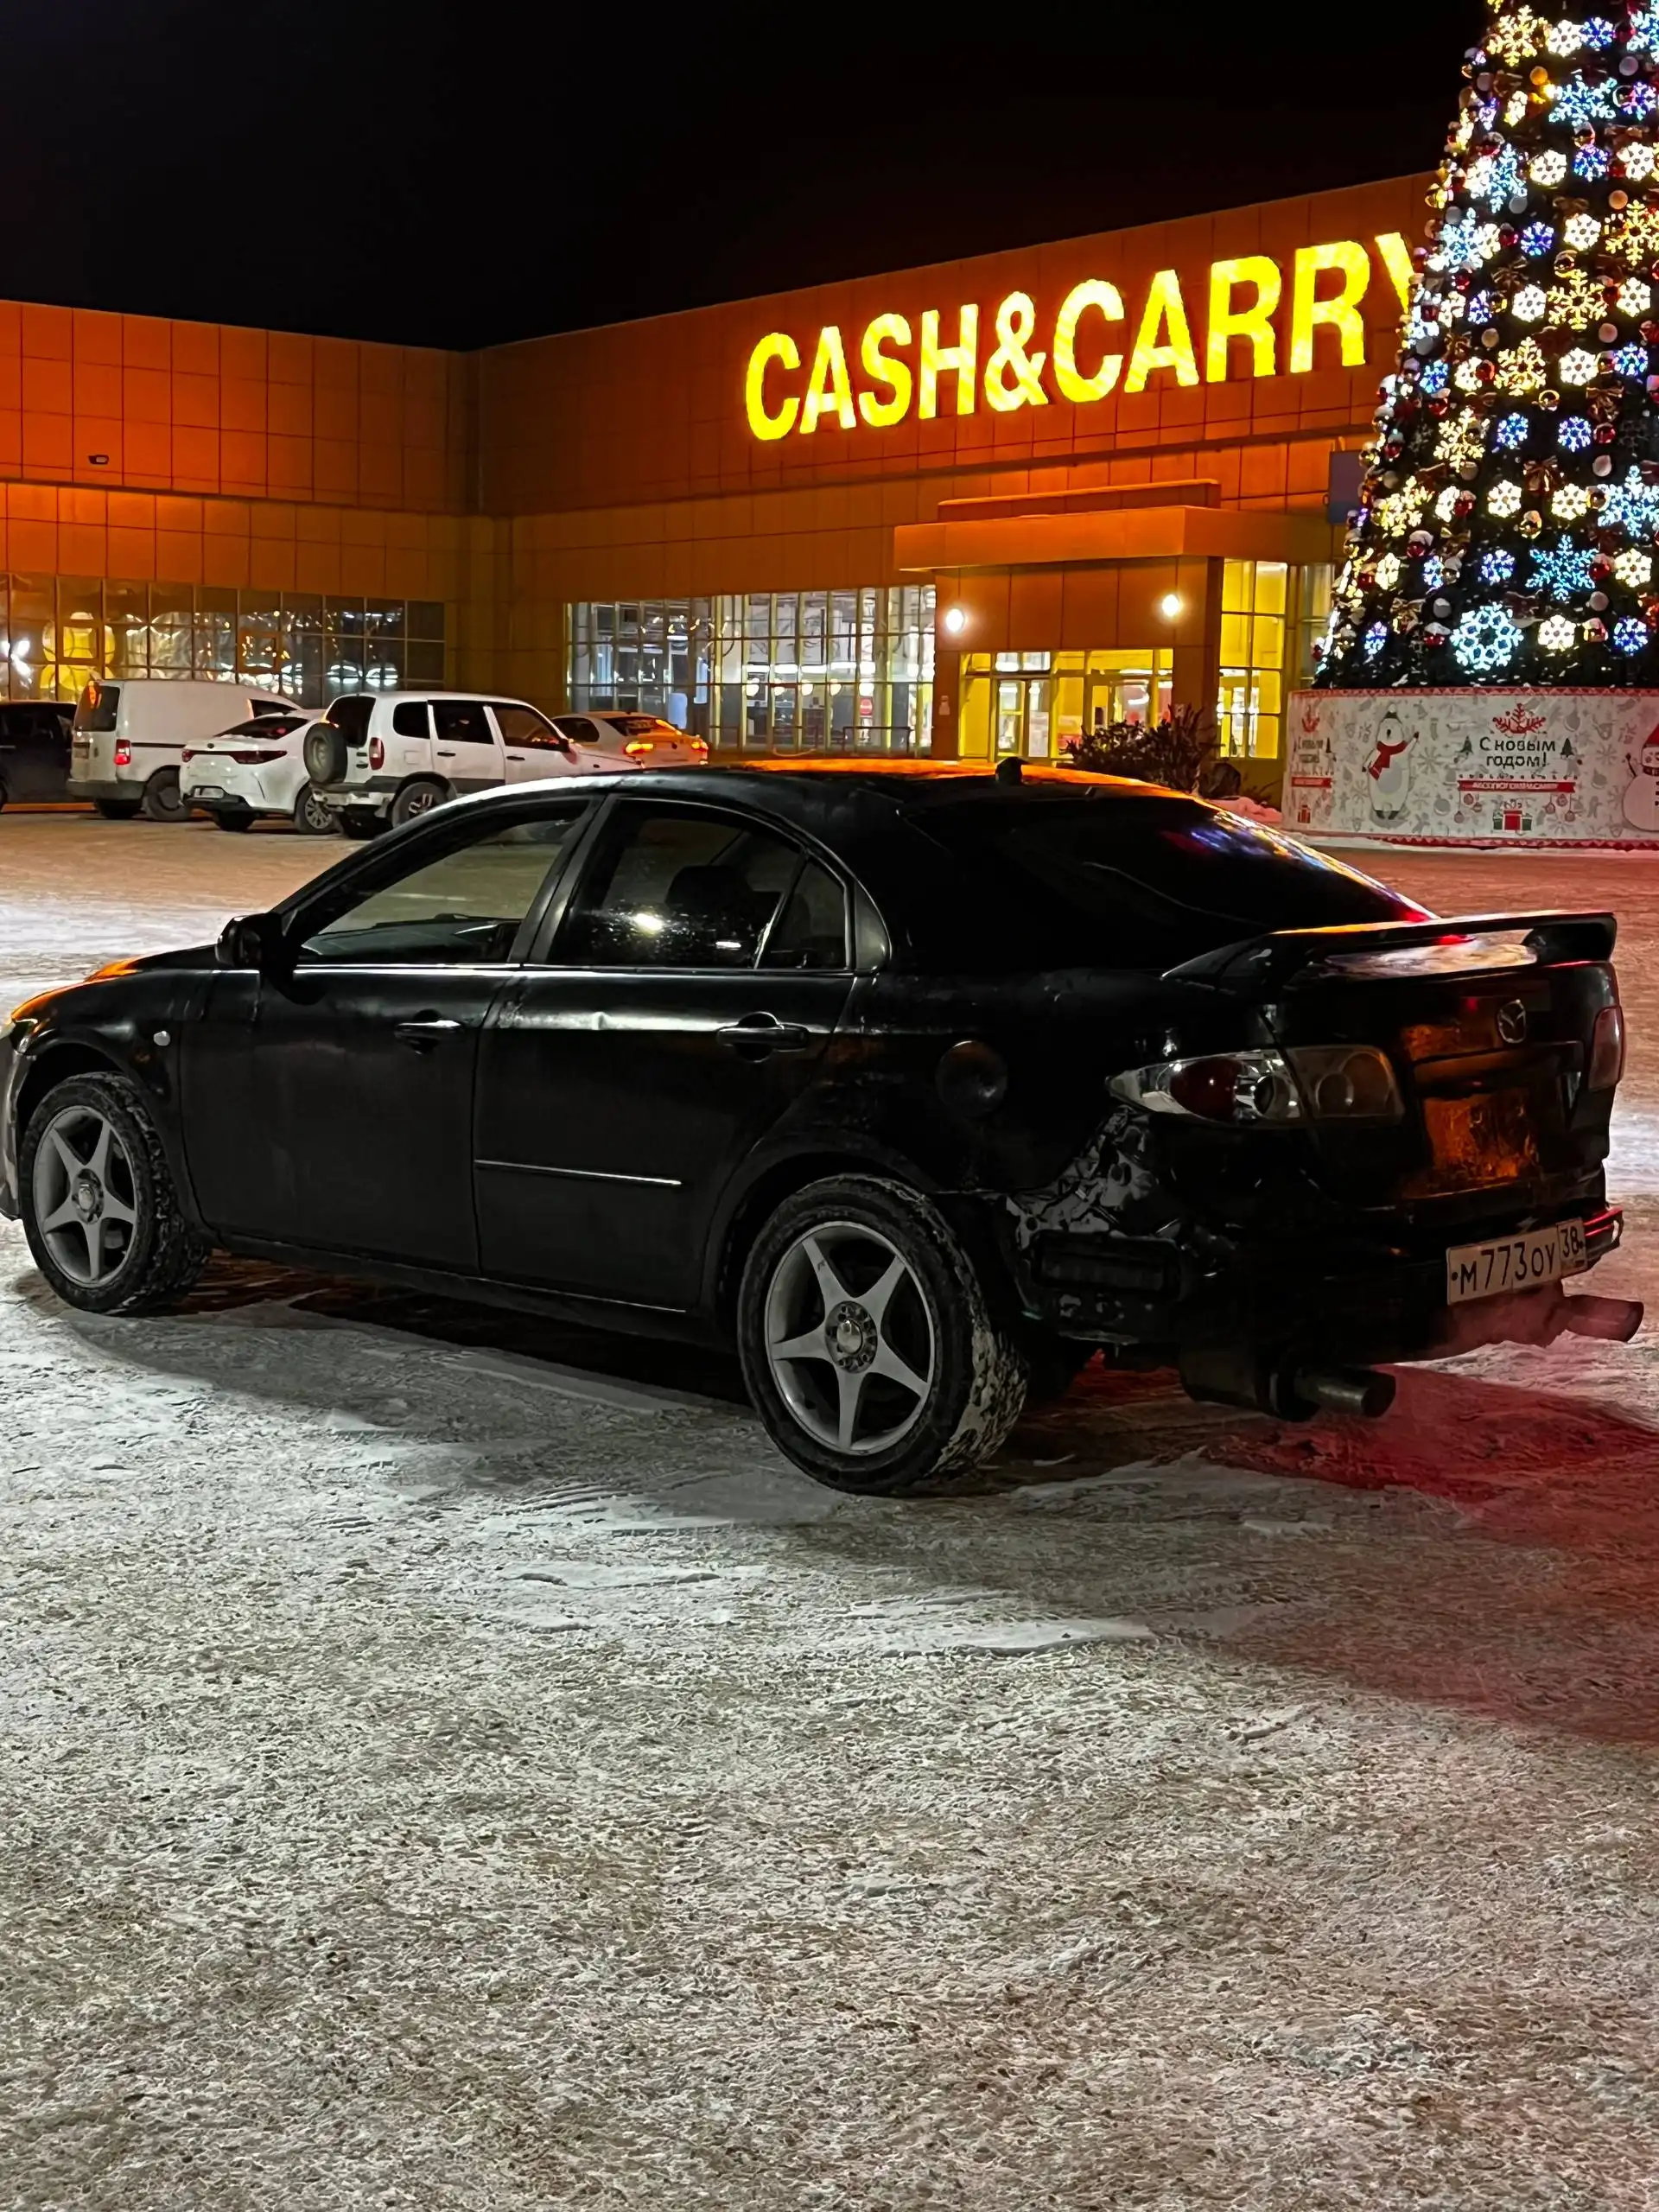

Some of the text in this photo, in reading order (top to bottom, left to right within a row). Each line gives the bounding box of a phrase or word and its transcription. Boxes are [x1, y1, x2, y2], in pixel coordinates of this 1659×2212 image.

[1479, 736, 1556, 752] С новым
[1486, 753, 1548, 769] годом!
